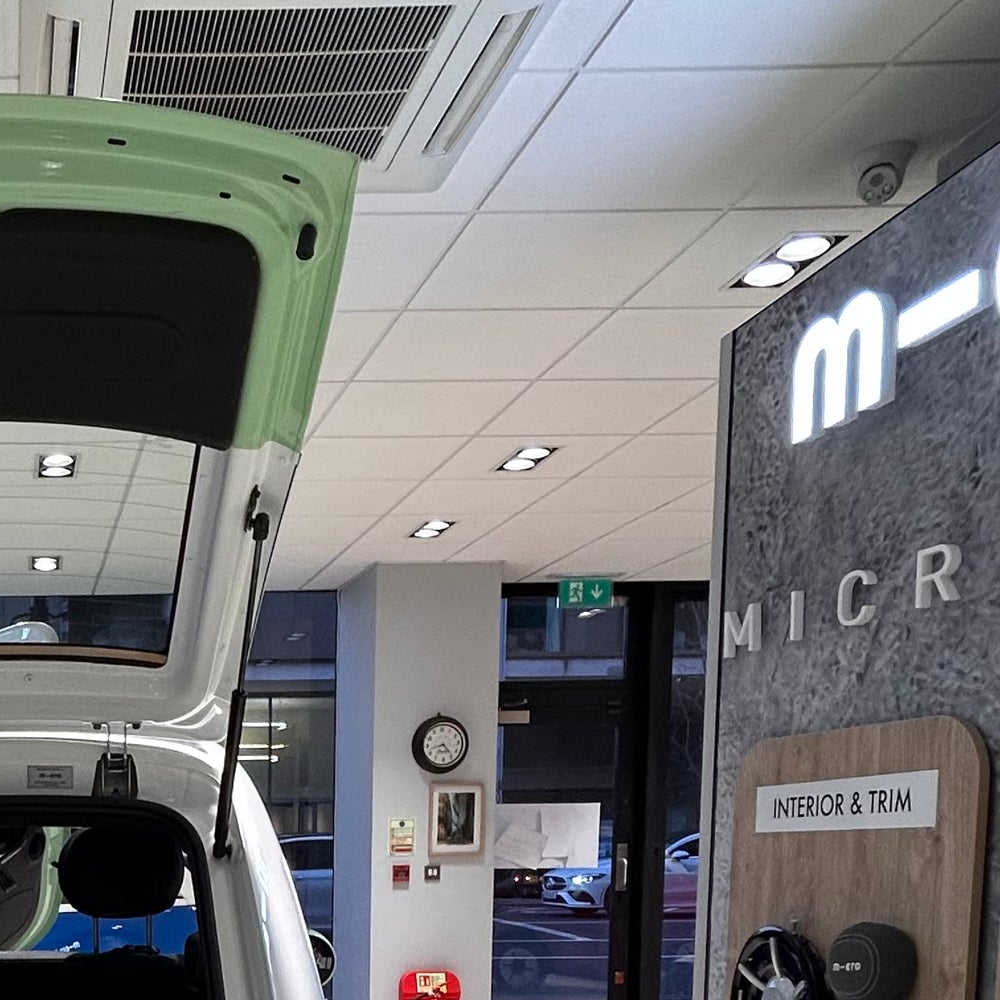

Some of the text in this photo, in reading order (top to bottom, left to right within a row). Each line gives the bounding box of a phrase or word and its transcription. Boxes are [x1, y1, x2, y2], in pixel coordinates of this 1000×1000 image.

[773, 787, 912, 819] INTERIOR & TRIM
